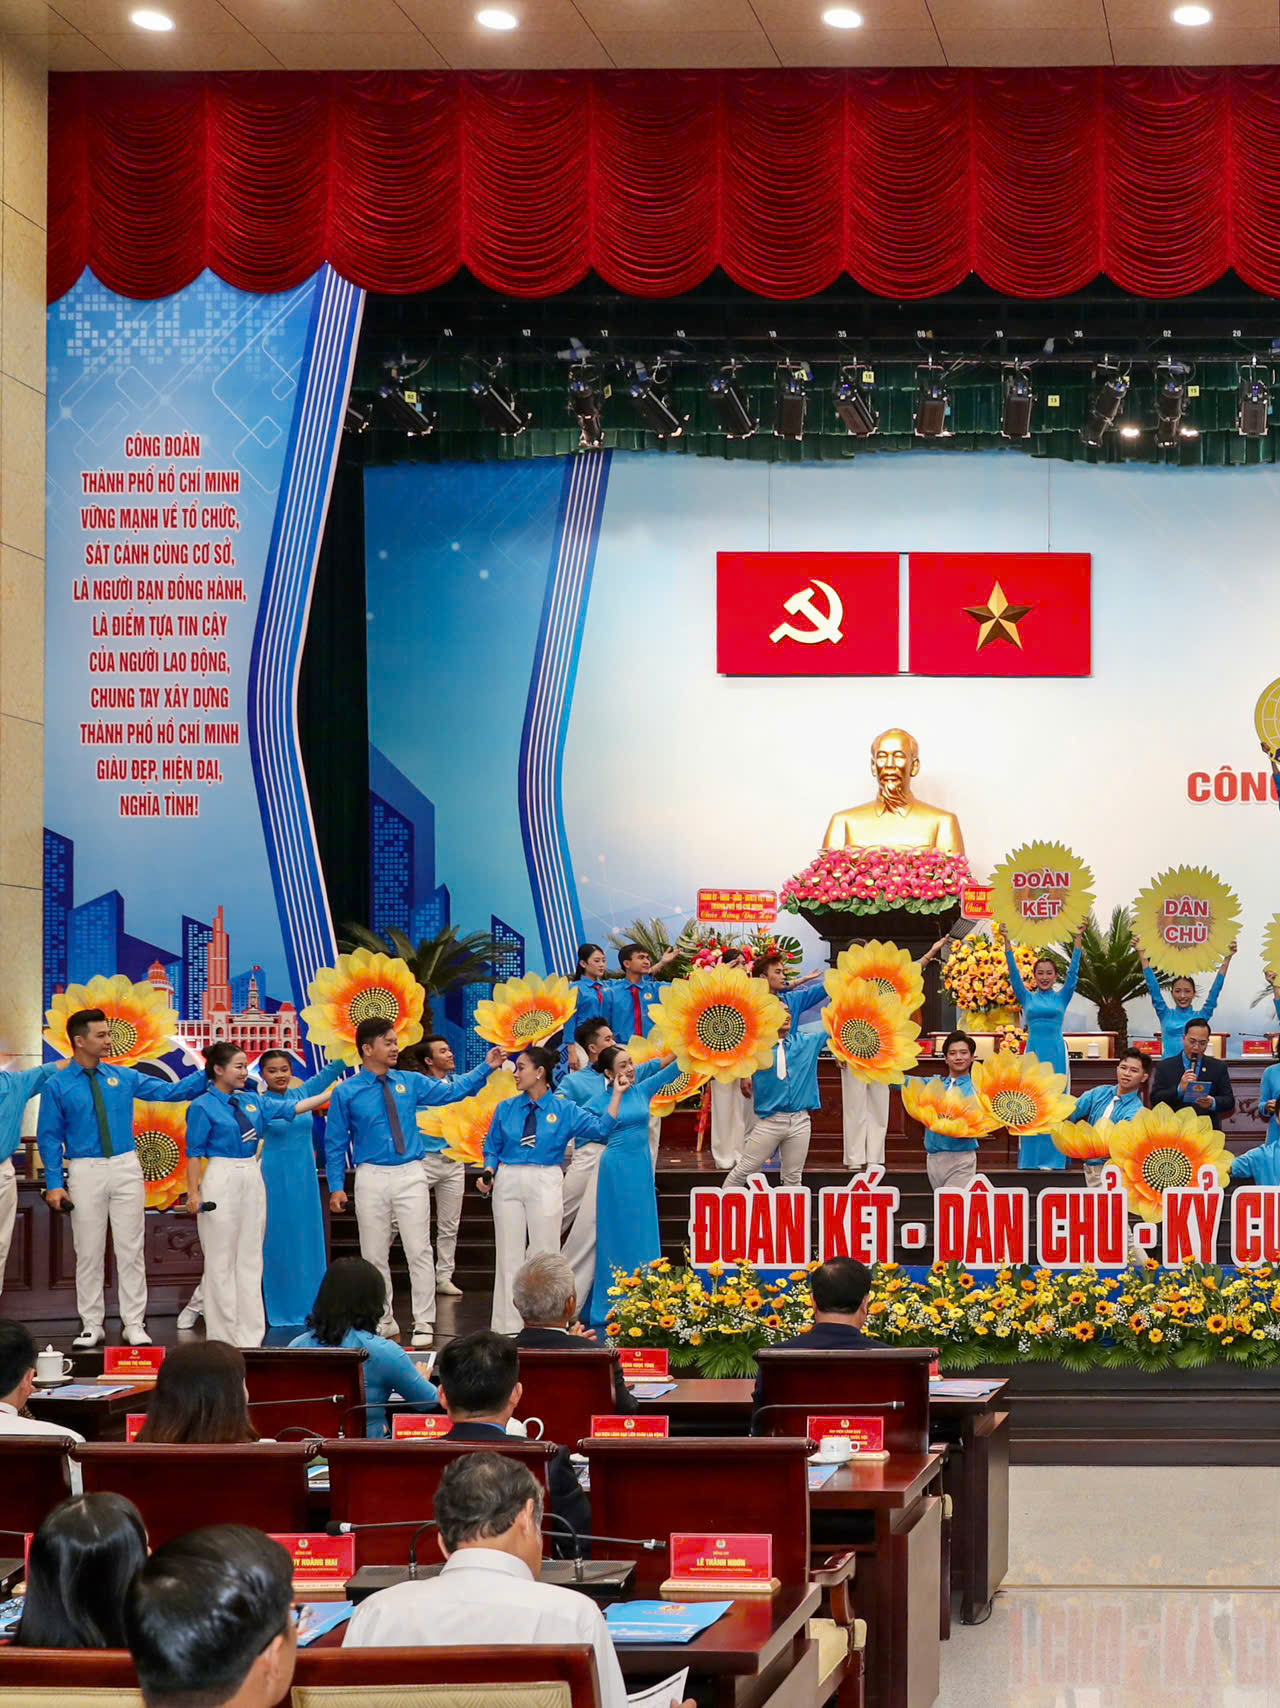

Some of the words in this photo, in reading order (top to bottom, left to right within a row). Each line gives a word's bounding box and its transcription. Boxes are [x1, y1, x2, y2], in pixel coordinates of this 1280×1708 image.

[125, 433, 161, 458] CÔNG
[165, 435, 201, 457] ĐOÀN
[82, 472, 126, 494] THÀNH
[127, 468, 155, 494] PHỐ
[158, 468, 177, 494] HỒ
[179, 472, 201, 494] CHÍ
[205, 471, 241, 493] MINH
[80, 505, 117, 529] VỮNG
[119, 508, 160, 534] MẠNH
[162, 503, 179, 529] VỀ
[181, 503, 199, 529] TỔ
[201, 507, 241, 529] CHỨC,
[86, 544, 112, 566] SÁT
[113, 543, 151, 566] CÁNH
[153, 543, 190, 566] CÙNG
[192, 542, 211, 565] CƠ
[213, 538, 236, 565] SỞ,
[73, 580, 91, 601] LÀ
[93, 578, 135, 601] NGƯỜI
[137, 579, 165, 601] BẠN
[167, 575, 205, 601] ĐỒNG
[207, 579, 247, 601] HÀNH,
[93, 615, 110, 638] LÀ
[111, 607, 147, 638] ĐIỂM
[149, 615, 175, 641] TỰA
[177, 615, 200, 638] TIN
[202, 613, 228, 641] CẬY
[89, 645, 117, 673] CỦA
[119, 647, 161, 673] NGƯỜI
[163, 651, 188, 673] LAO
[191, 647, 231, 677] ĐỘNG,
[91, 687, 137, 710] CHUNG
[139, 687, 161, 709] TAY
[164, 683, 190, 709] XÂY
[193, 687, 230, 713] DỰNG
[79, 722, 124, 745] THÀNH
[127, 719, 155, 745] PHỐ
[157, 722, 176, 745] HỒ
[178, 723, 201, 745] CHÍ
[204, 723, 241, 745] MINH
[97, 759, 129, 781] GIÀU
[131, 759, 159, 785] ĐẸP,
[162, 755, 195, 785] HIỆN
[197, 759, 223, 785] ĐẠI,
[120, 791, 161, 817] NGHĨA
[164, 795, 200, 817] TÌNH!
[1013, 868, 1070, 888] ĐOÀN
[1023, 894, 1061, 916] KẾT
[1164, 896, 1209, 916] DÂN
[1164, 923, 1208, 943] CHỦ
[693, 1179, 801, 1264] ĐOÀN
[823, 1171, 897, 1264] KẾT
[939, 1179, 1024, 1264] DÂN
[1041, 1171, 1124, 1264] CHỦ
[1167, 1171, 1219, 1263] KỶ
